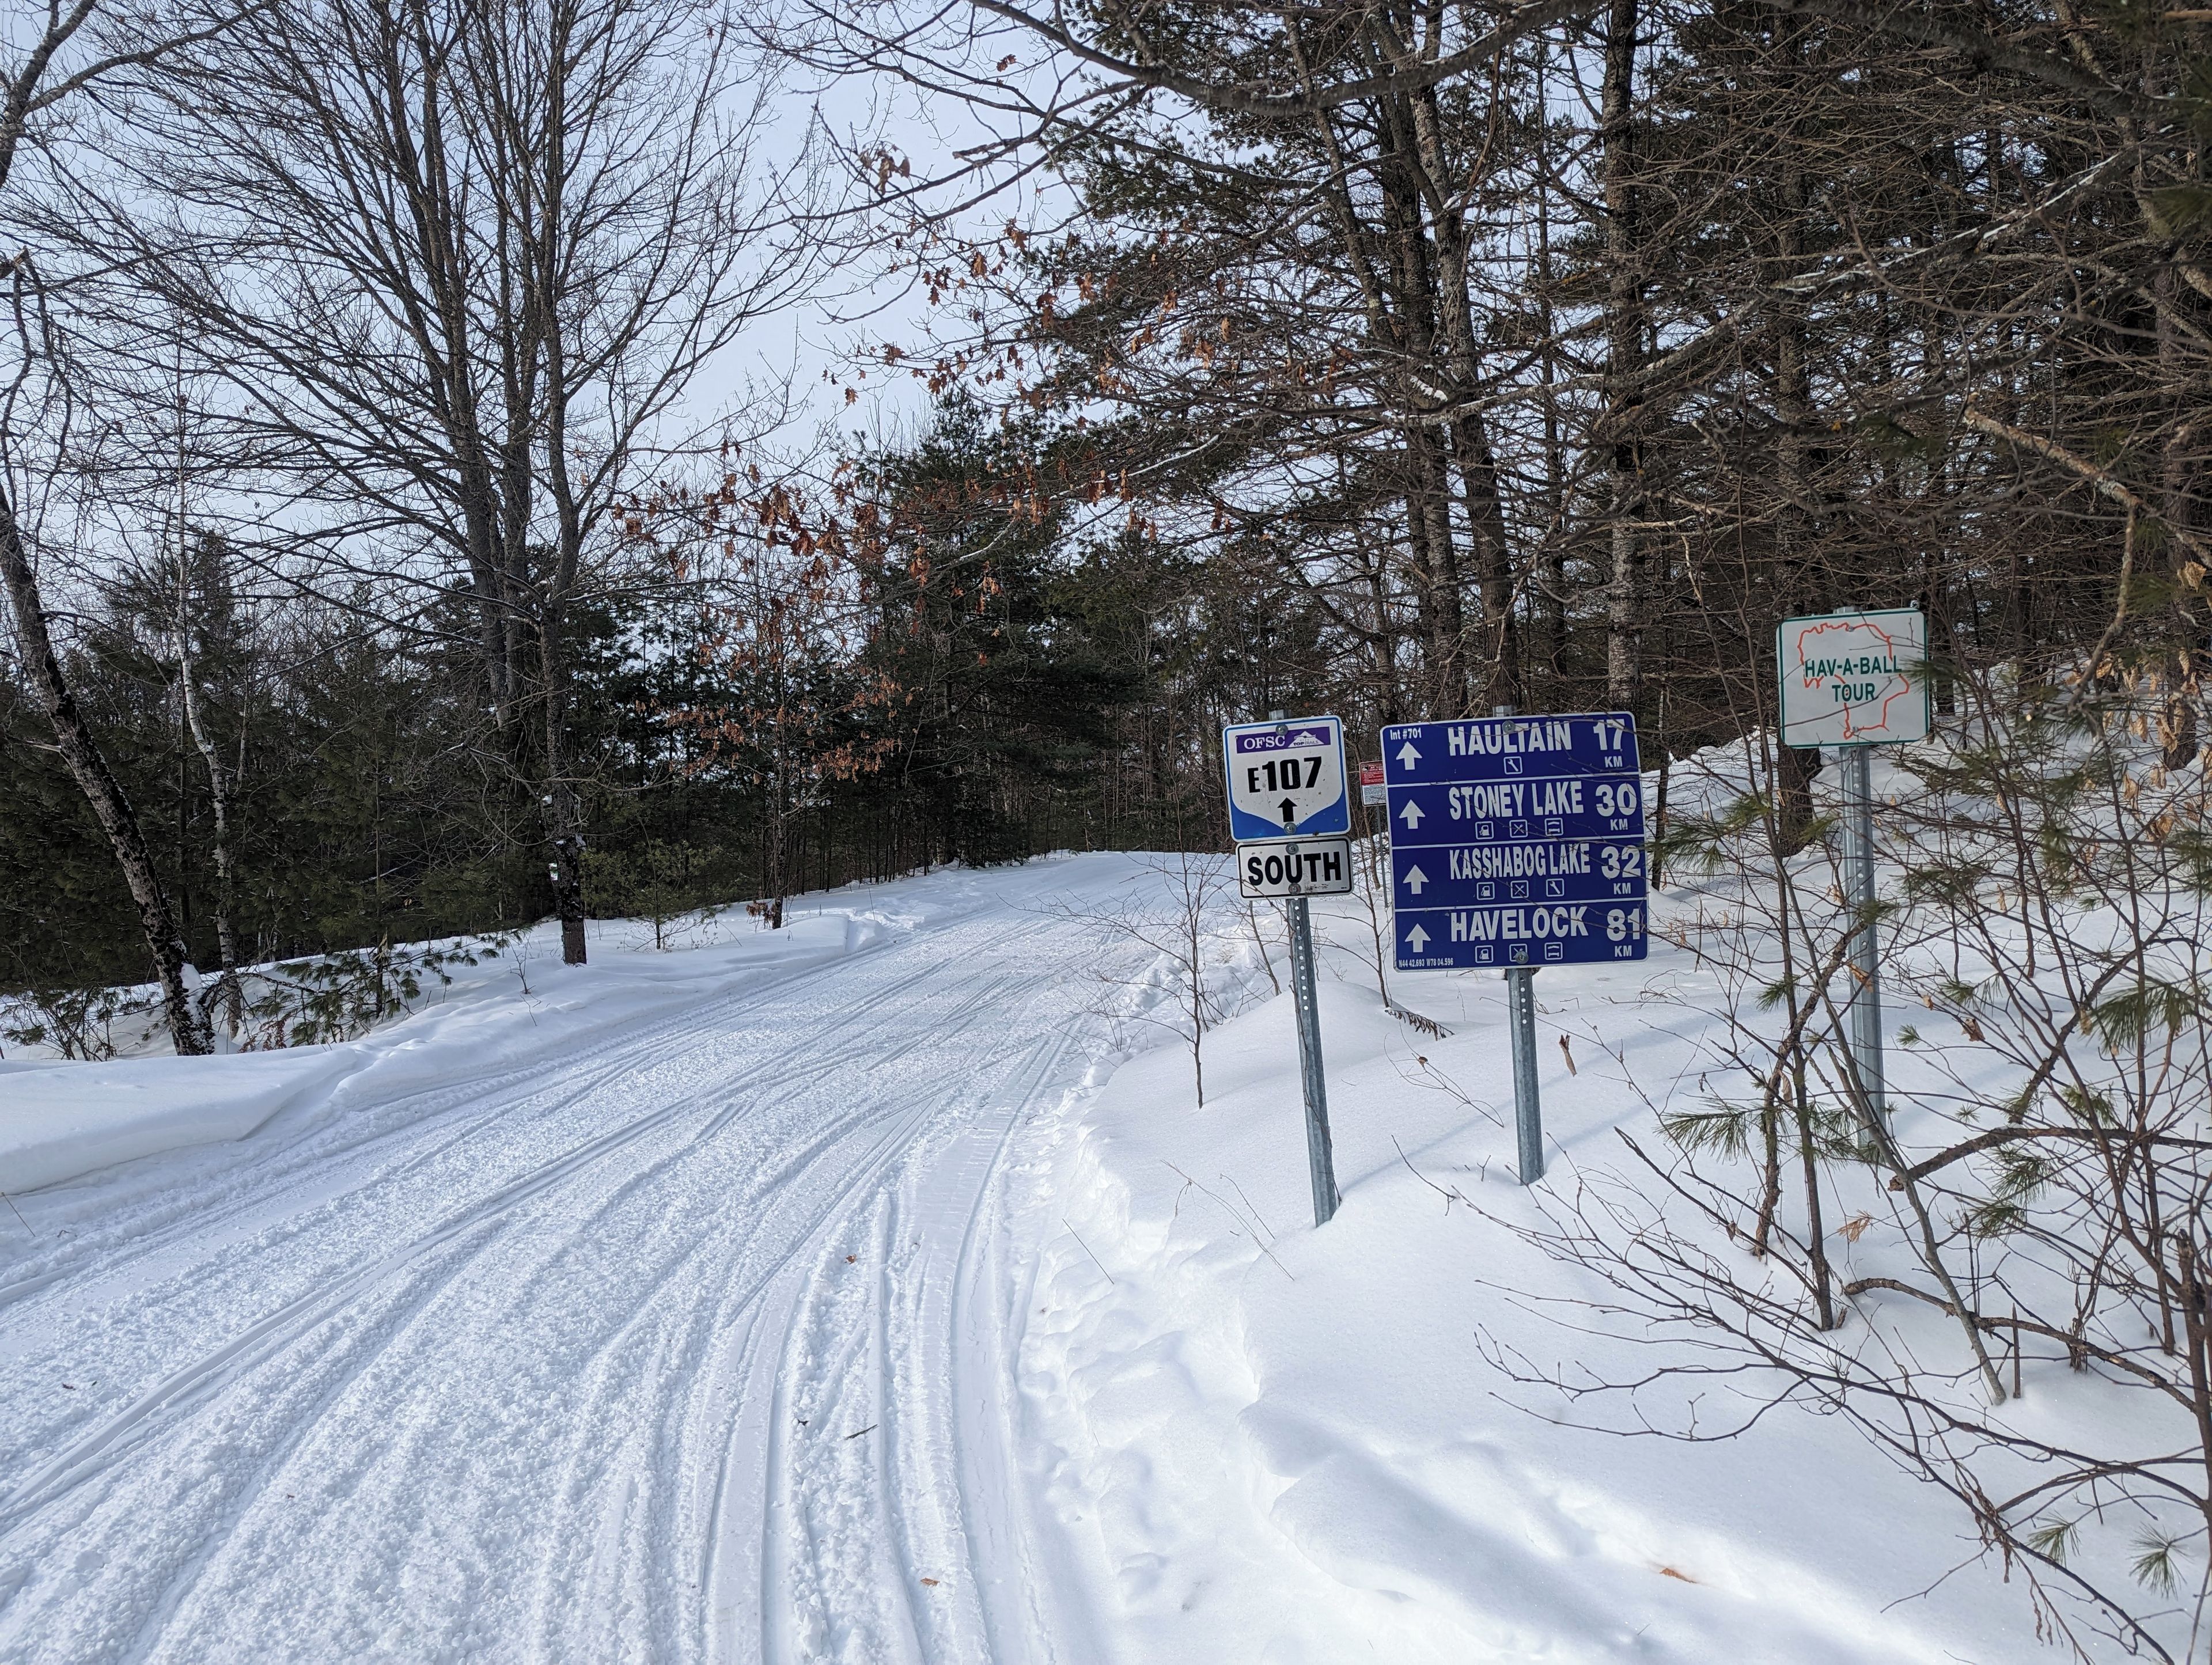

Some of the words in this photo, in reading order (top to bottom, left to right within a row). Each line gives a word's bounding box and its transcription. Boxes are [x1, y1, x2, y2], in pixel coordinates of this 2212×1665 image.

[1805, 655, 1902, 677] HAV-A-BALL
[1832, 682, 1875, 702] TOUR
[1244, 735, 1286, 749] OFSC
[1390, 729, 1401, 740] Int
[1403, 727, 1422, 739] #701
[1448, 720, 1571, 756] HAULTAIN
[1593, 719, 1624, 750] 17
[1604, 756, 1623, 768] KM
[1247, 756, 1322, 793] E107
[1449, 784, 1525, 820] STONEY
[1532, 781, 1584, 816] LAKE
[1596, 784, 1637, 817] 30
[1610, 818, 1628, 831] KM
[1248, 851, 1342, 886] SOUTH
[1449, 845, 1546, 880] KASSHABOG
[1550, 843, 1590, 875] LAKE
[1601, 845, 1641, 879] 32
[1613, 882, 1631, 894] KM
[1450, 907, 1588, 942] HAVELOCK
[1606, 908, 1641, 941] 81
[1614, 945, 1632, 957] KM
[1399, 959, 1408, 968] N44
[1409, 959, 1425, 967] 42.693
[1426, 958, 1436, 966] W78
[1437, 958, 1453, 966] 04.596
